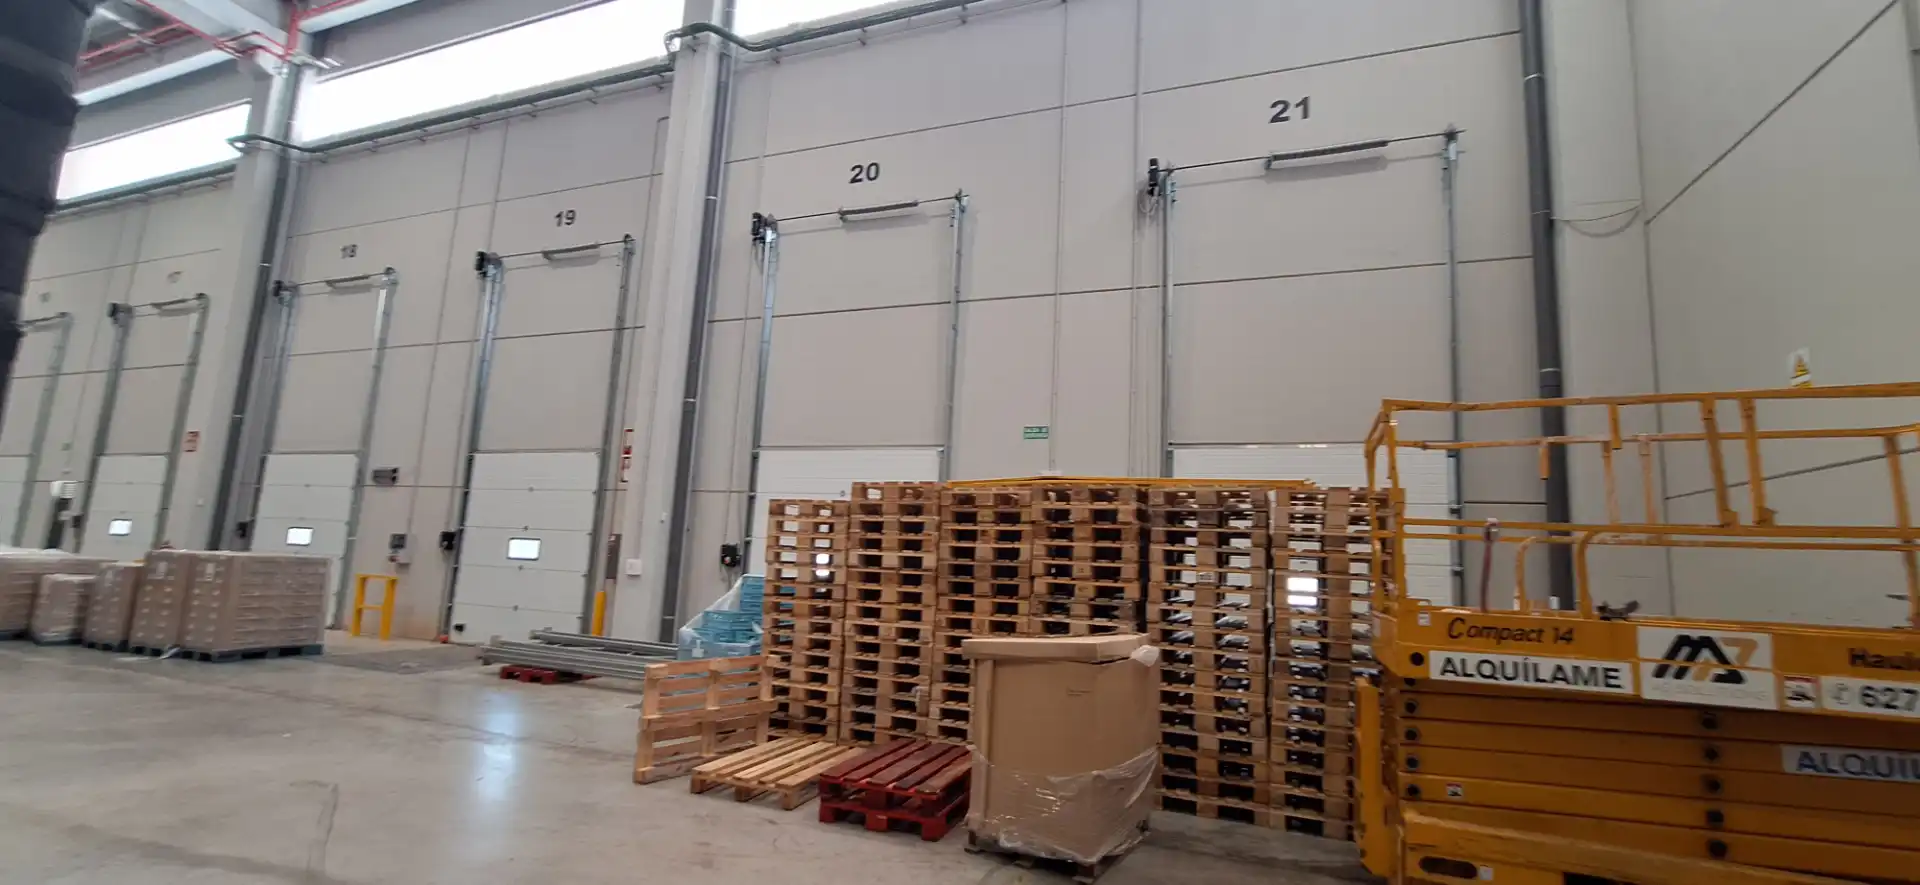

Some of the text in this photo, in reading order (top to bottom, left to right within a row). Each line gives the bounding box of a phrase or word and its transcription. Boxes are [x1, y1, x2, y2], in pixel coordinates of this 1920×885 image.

[1268, 96, 1310, 124] 21
[849, 162, 879, 184] 20
[554, 209, 576, 227] 19
[1448, 617, 1574, 645] Compact 14
[1440, 657, 1625, 688] ALQUÍLAME
[1859, 685, 1919, 712] 627
